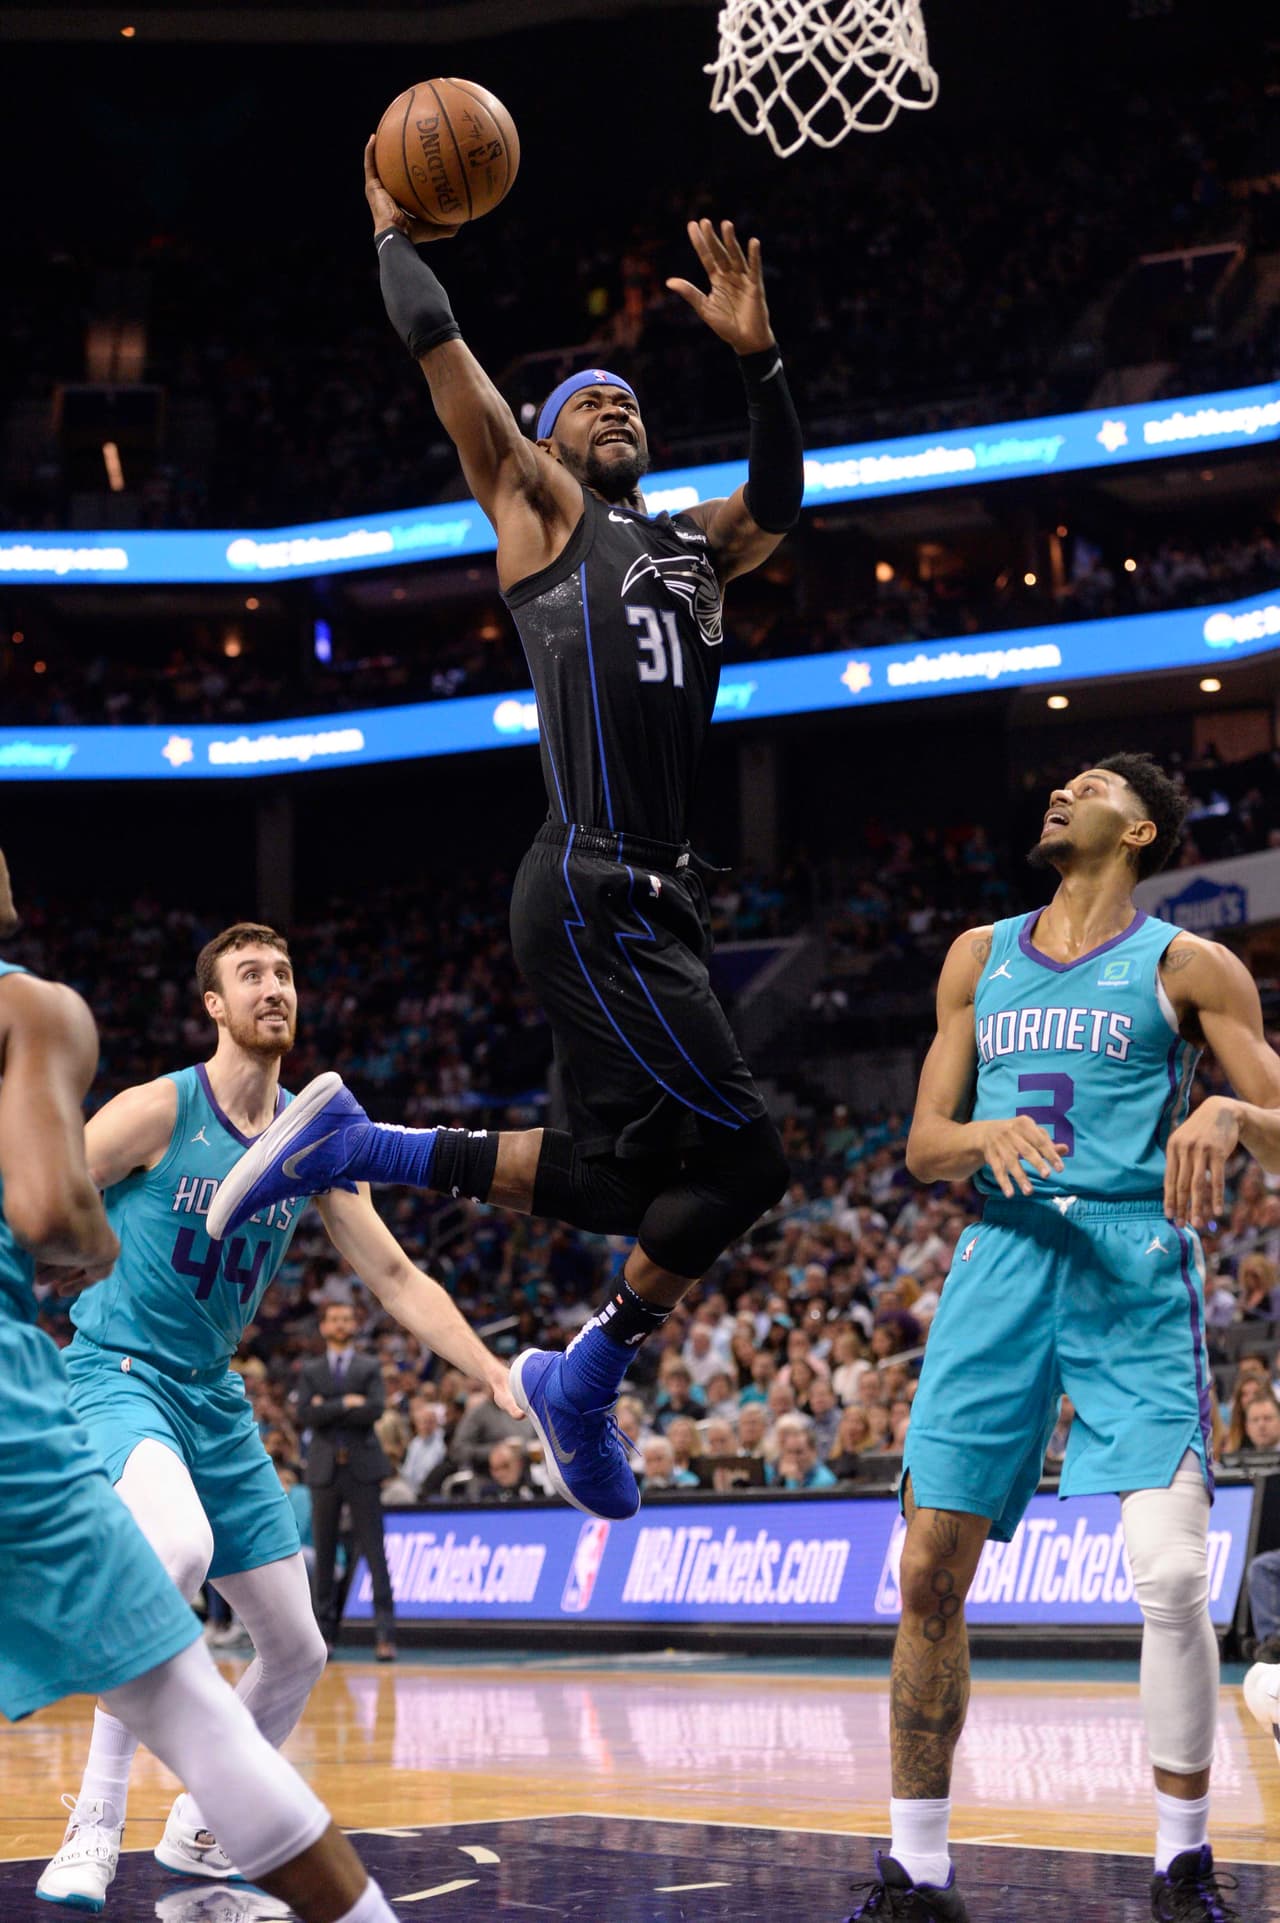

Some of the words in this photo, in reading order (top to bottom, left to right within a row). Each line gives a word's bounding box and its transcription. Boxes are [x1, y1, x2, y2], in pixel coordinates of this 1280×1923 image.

[416, 115, 462, 213] SPALDING
[625, 603, 686, 690] 31
[976, 1006, 1134, 1064] HORNETS
[1015, 1072, 1077, 1158] 3
[170, 1226, 273, 1305] 44
[621, 1525, 851, 1604] NBATickets.com
